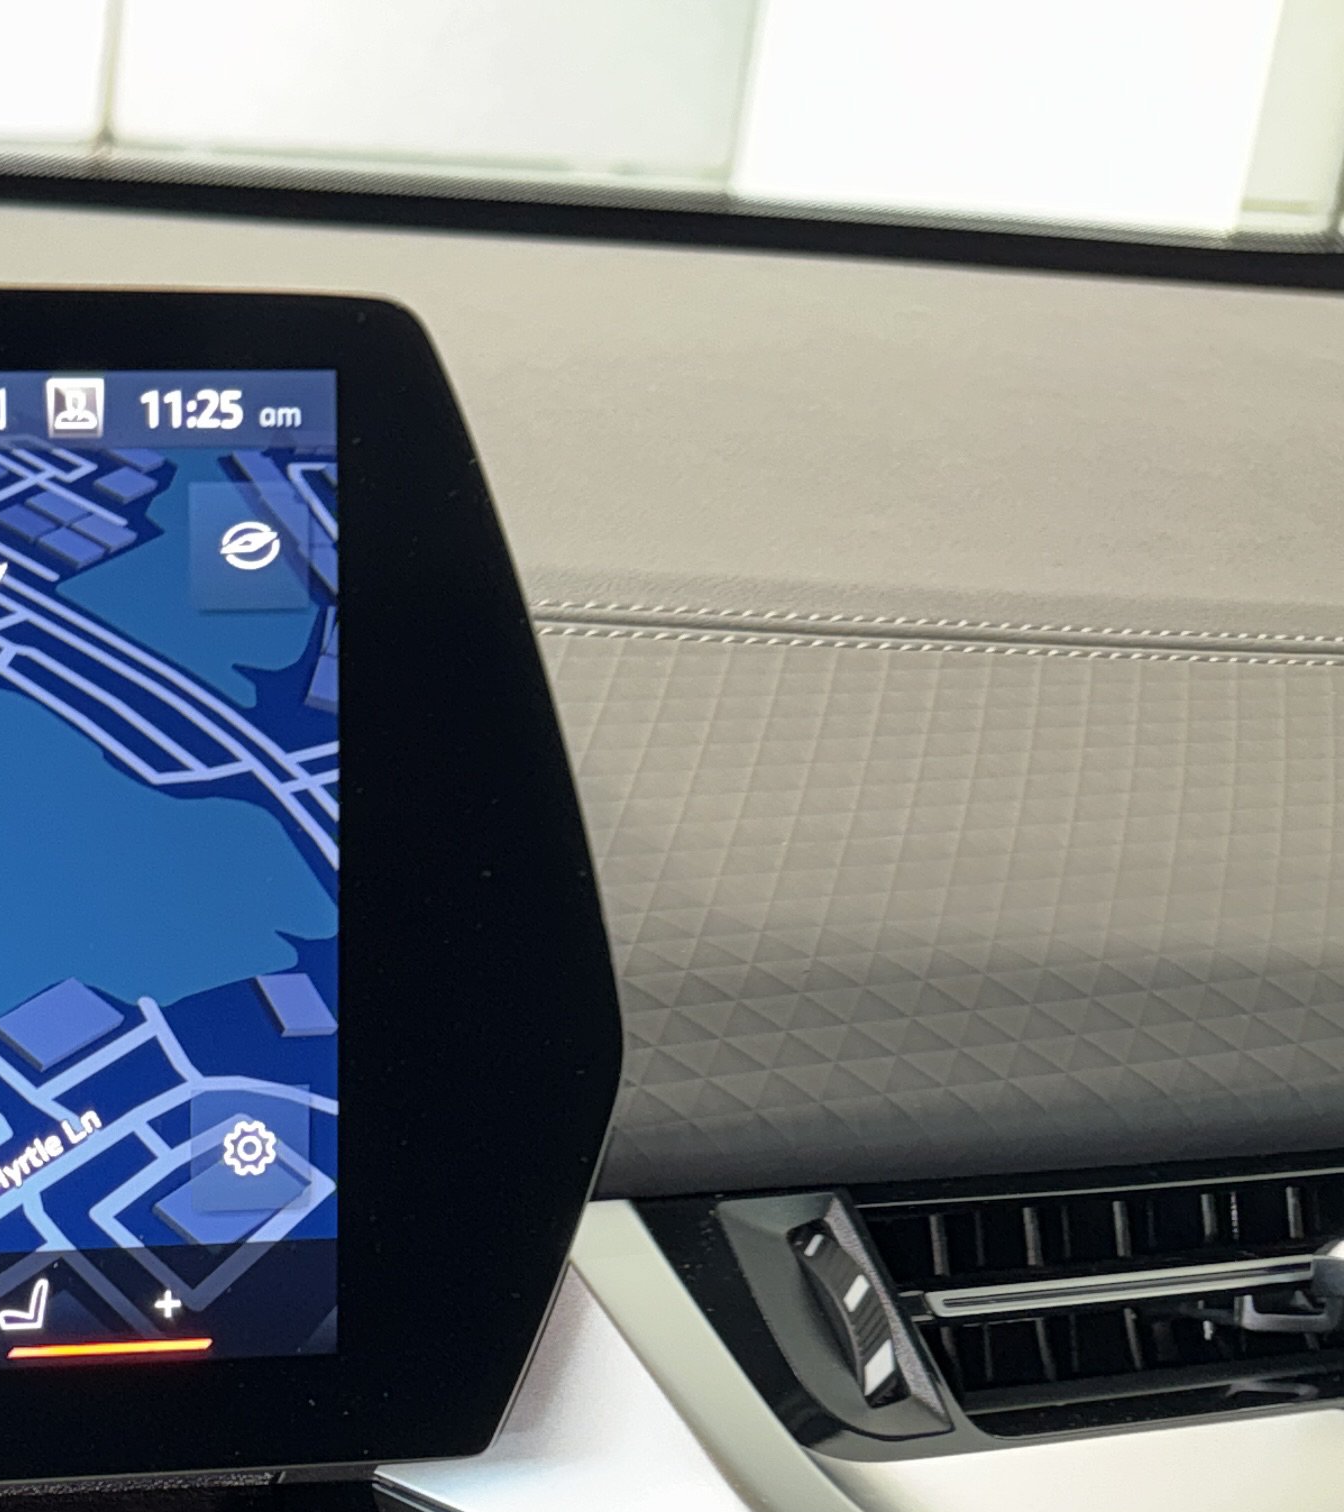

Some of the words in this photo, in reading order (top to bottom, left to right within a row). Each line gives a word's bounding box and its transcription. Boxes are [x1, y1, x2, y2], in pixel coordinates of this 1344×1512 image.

[140, 389, 243, 430] 11:25
[259, 406, 302, 428] am
[62, 1110, 103, 1144] Ln
